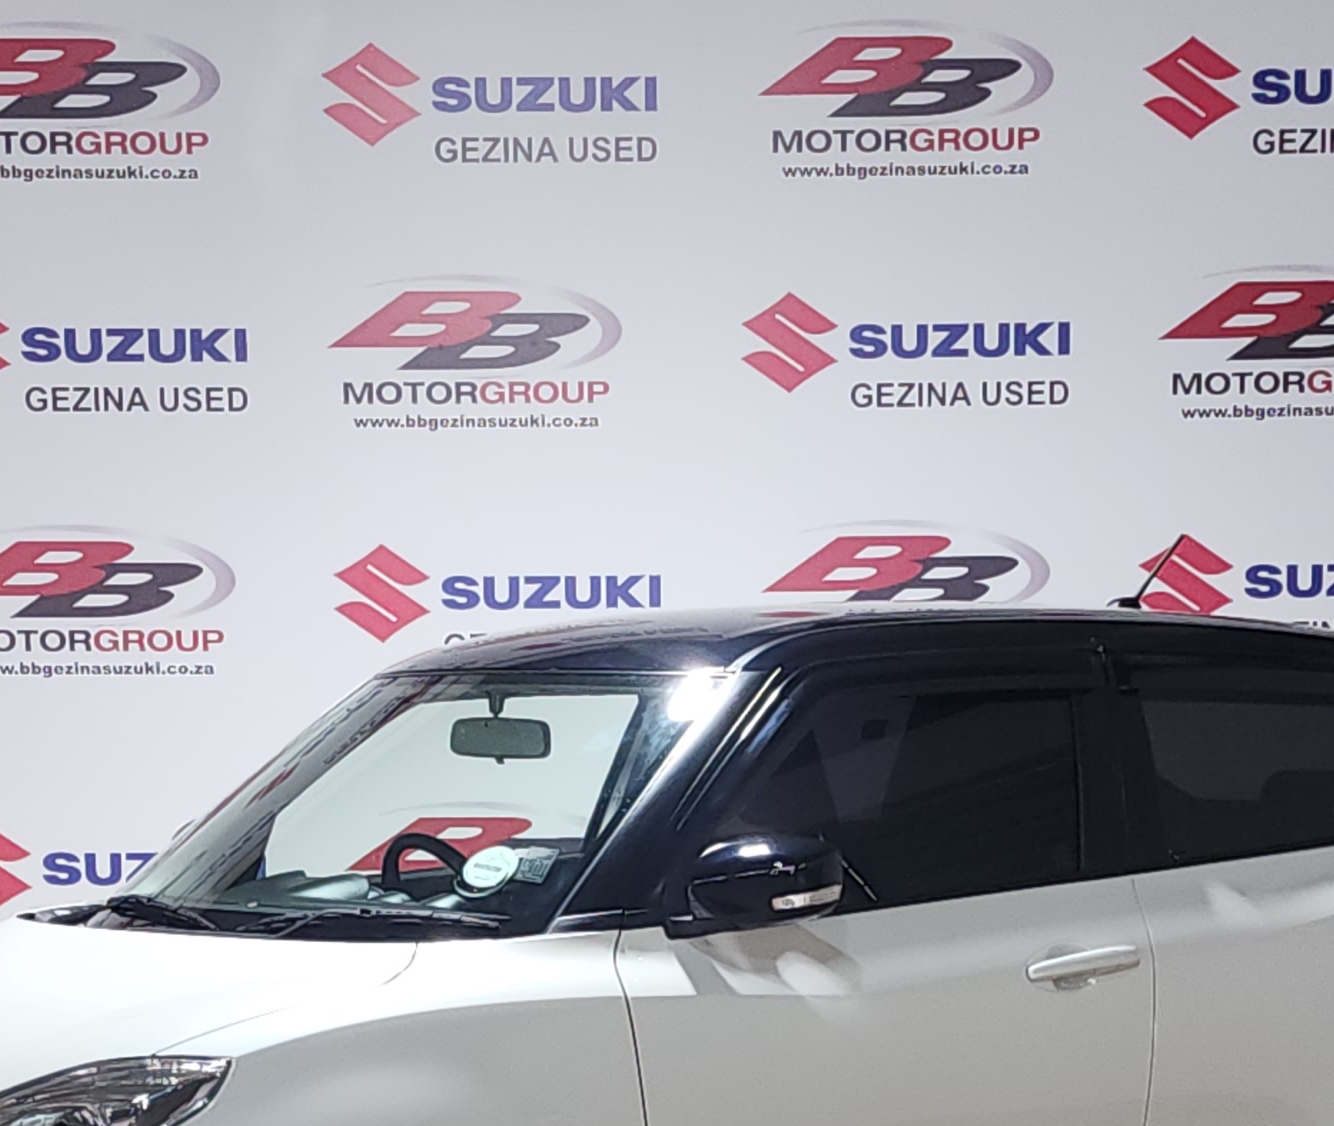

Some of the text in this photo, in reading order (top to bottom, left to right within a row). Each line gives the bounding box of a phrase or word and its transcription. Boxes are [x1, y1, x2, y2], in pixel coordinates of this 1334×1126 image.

[760, 36, 1022, 117] BB
[432, 76, 657, 113] SUZUKI
[435, 137, 657, 163] GEZINA USED
[773, 127, 1040, 153] MOTORGROUP
[782, 161, 1028, 180] www.bbgezinasuzuki.co.za
[21, 327, 247, 363] SUZUKI
[328, 291, 590, 370] BB
[849, 322, 1070, 359] SUZUKI
[25, 387, 247, 412] GEZINA USED
[343, 381, 609, 404] MOTORGROUP
[851, 380, 1069, 407] GEZINA USED
[353, 414, 598, 431] www.bbgezinasuzuki.co.za
[442, 575, 661, 610] SUZUKI
[42, 852, 158, 886] SUZ
